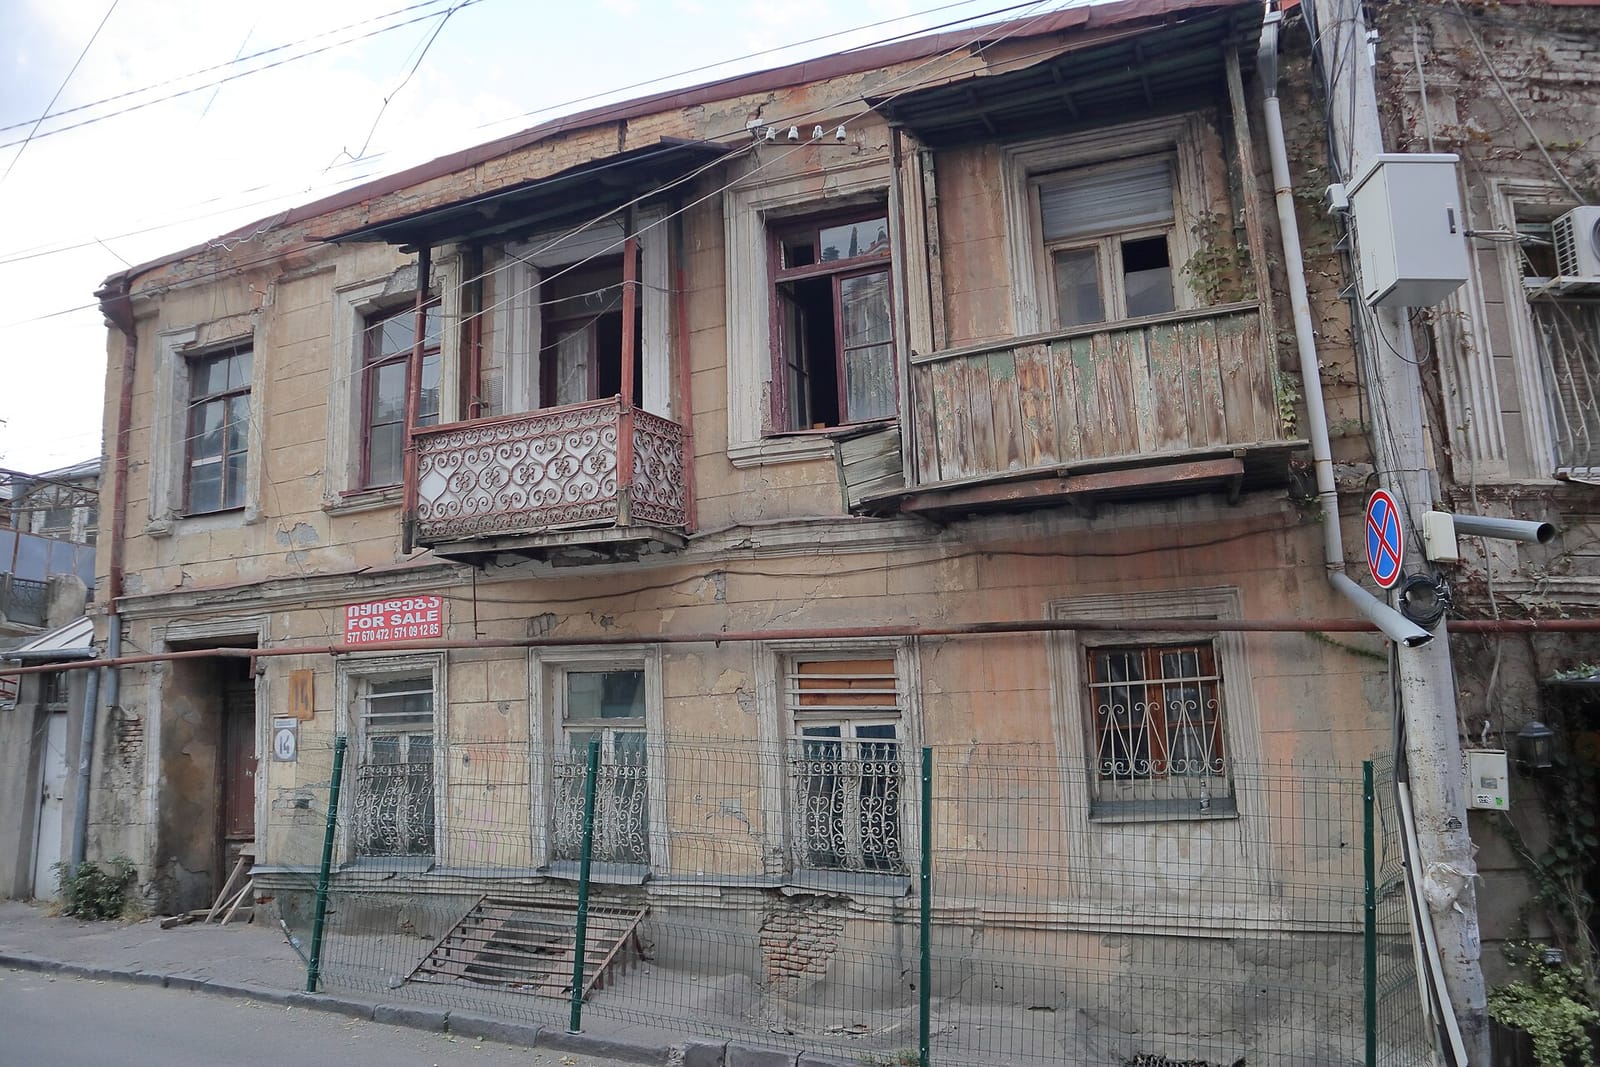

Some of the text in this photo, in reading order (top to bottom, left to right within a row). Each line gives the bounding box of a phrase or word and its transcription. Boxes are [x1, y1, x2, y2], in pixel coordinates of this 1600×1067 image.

[348, 597, 439, 617] იყიდება
[348, 610, 439, 630] FOR SALE
[347, 631, 361, 643] 577
[361, 630, 375, 642] 670
[376, 628, 389, 640] 472
[394, 626, 407, 638] 571
[408, 625, 418, 637] 09
[419, 624, 428, 636] 12
[429, 623, 439, 635] 85
